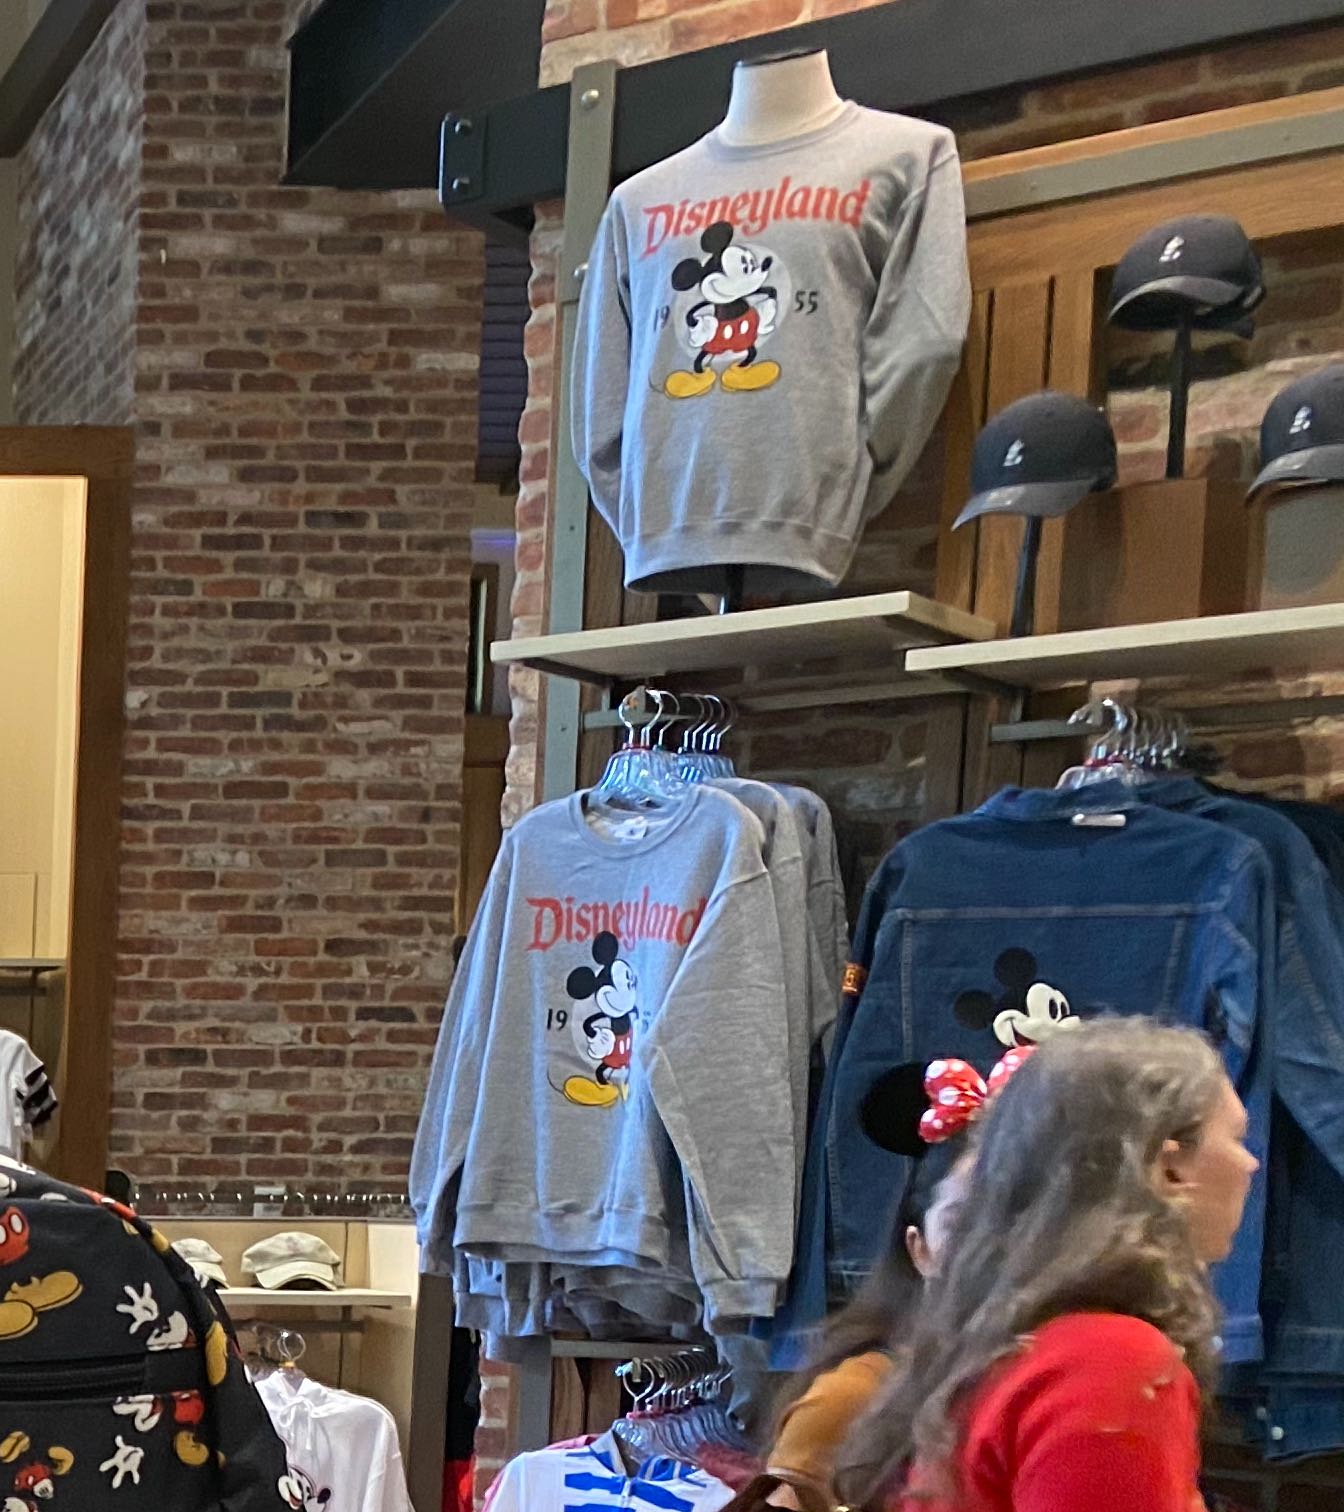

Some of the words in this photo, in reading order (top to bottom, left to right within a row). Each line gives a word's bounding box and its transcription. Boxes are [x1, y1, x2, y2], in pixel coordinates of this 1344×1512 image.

[642, 176, 871, 259] Disneyland
[795, 291, 819, 315] 55
[526, 885, 709, 952] Disneyland
[547, 1008, 568, 1031] 19
